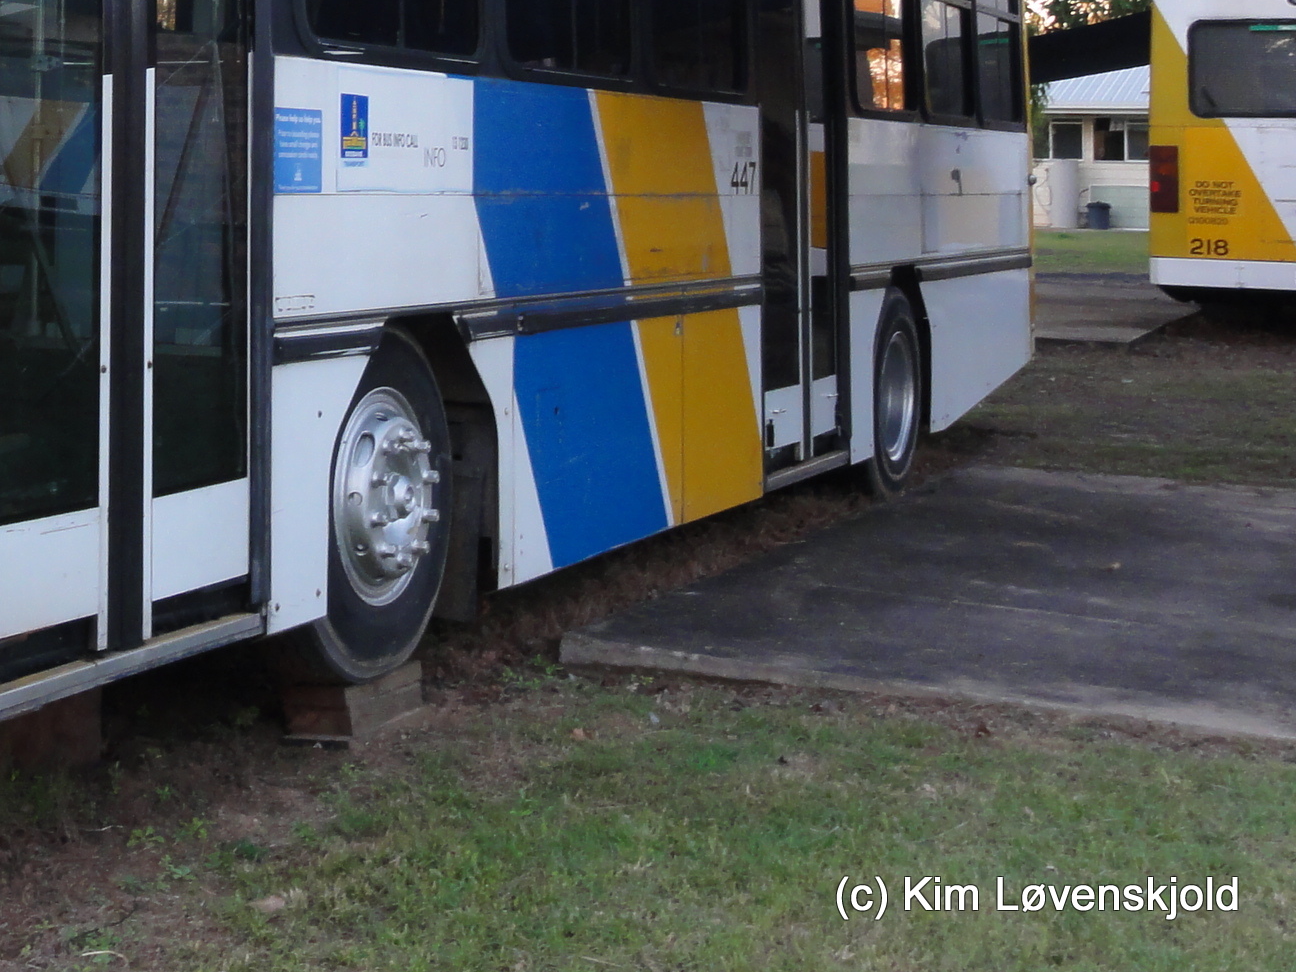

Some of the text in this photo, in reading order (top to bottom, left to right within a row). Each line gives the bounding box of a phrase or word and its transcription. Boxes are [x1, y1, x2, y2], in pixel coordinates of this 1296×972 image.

[371, 132, 419, 148] FOR BUS INFO CALL
[423, 147, 446, 168] INFO
[730, 161, 757, 196] 447
[1195, 180, 1234, 189] DO NOT
[1188, 188, 1242, 198] OVERTAKE
[1193, 197, 1239, 207] TURNING
[1194, 206, 1237, 215] VEHICLE
[1189, 237, 1230, 257] 218
